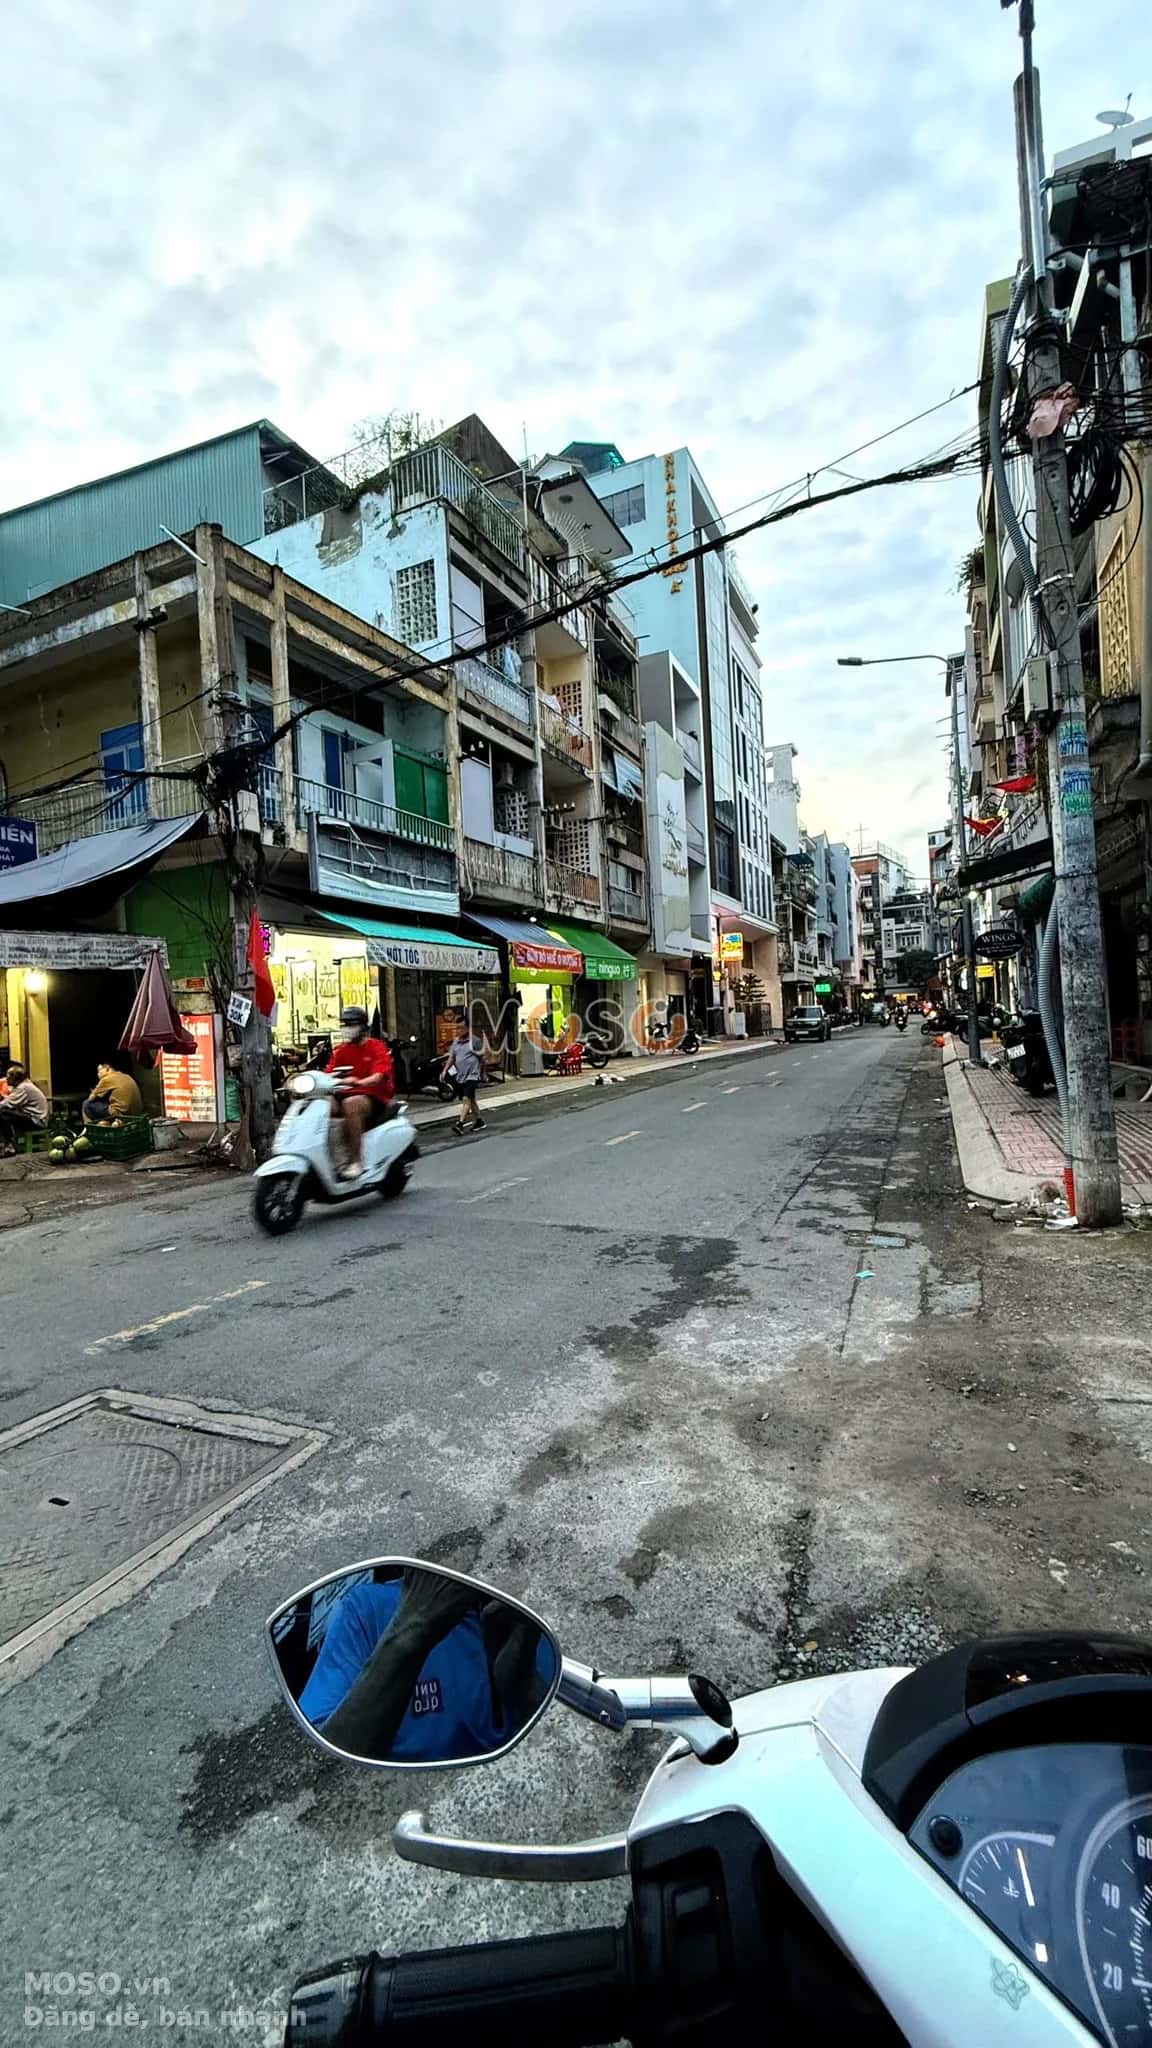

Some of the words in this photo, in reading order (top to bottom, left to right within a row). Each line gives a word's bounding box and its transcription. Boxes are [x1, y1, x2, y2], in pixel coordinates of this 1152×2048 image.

[981, 933, 1017, 943] WINGS
[1101, 1883, 1120, 1909] 40
[1103, 1962, 1123, 1992] 20
